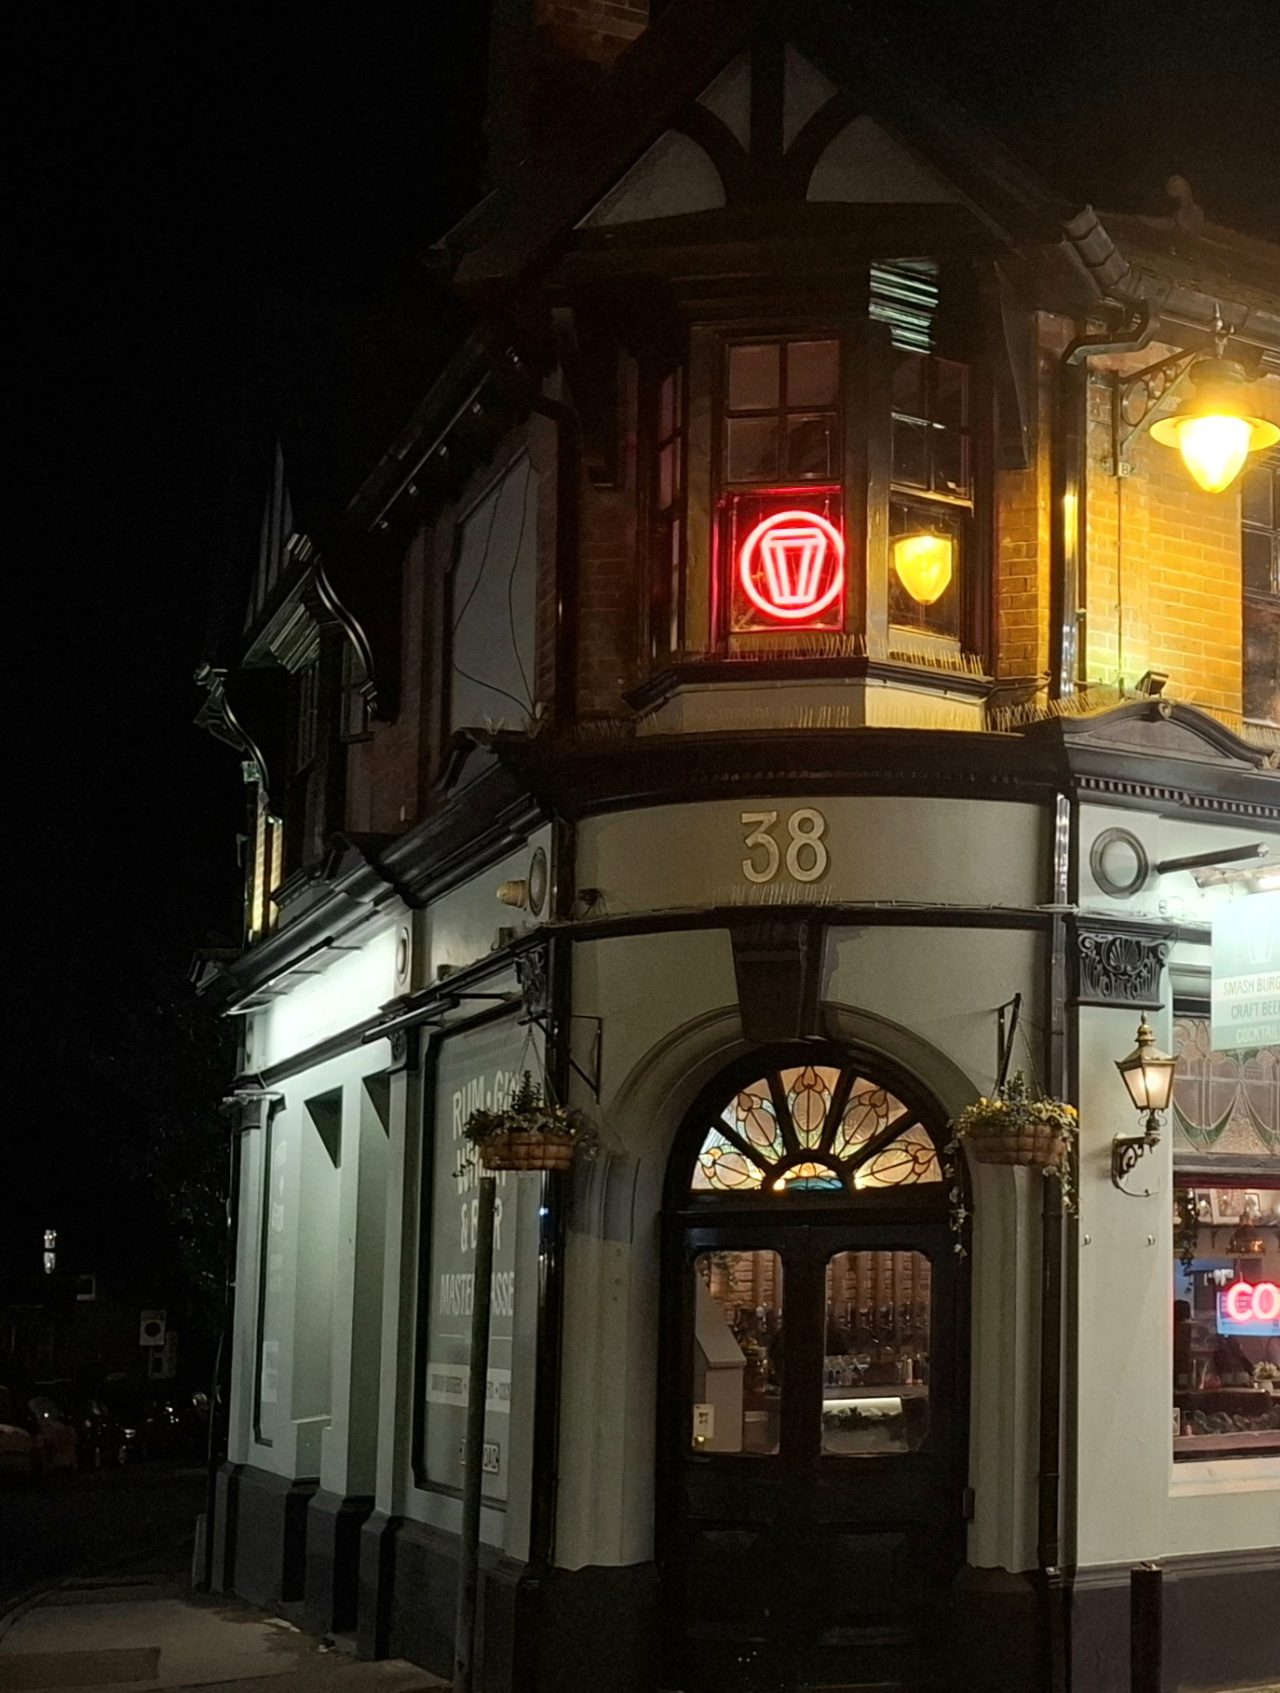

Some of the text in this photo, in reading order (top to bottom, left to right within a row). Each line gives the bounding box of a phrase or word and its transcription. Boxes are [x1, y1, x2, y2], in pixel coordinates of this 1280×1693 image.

[741, 808, 827, 883] 38
[1223, 977, 1254, 996] SMASH
[1231, 1001, 1259, 1020] CRAFT
